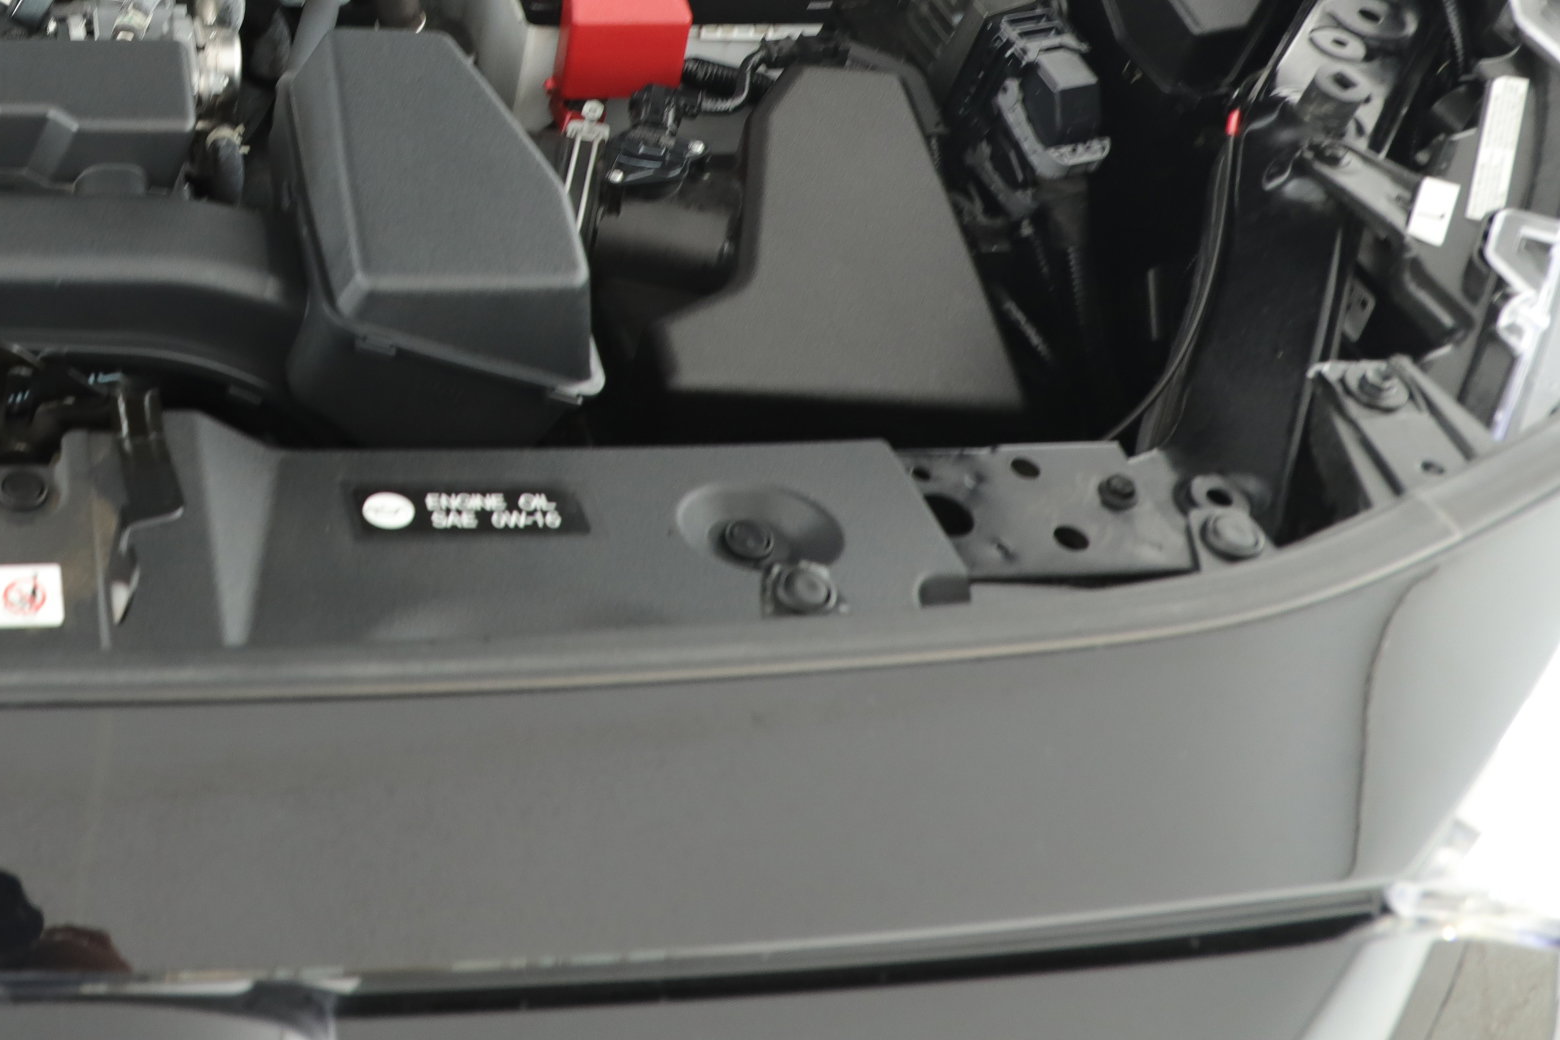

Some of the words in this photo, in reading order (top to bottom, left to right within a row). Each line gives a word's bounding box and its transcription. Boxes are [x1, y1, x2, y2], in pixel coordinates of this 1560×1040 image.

[425, 492, 507, 511] ENGINE
[518, 492, 556, 511] OIL
[430, 510, 478, 529] SAE
